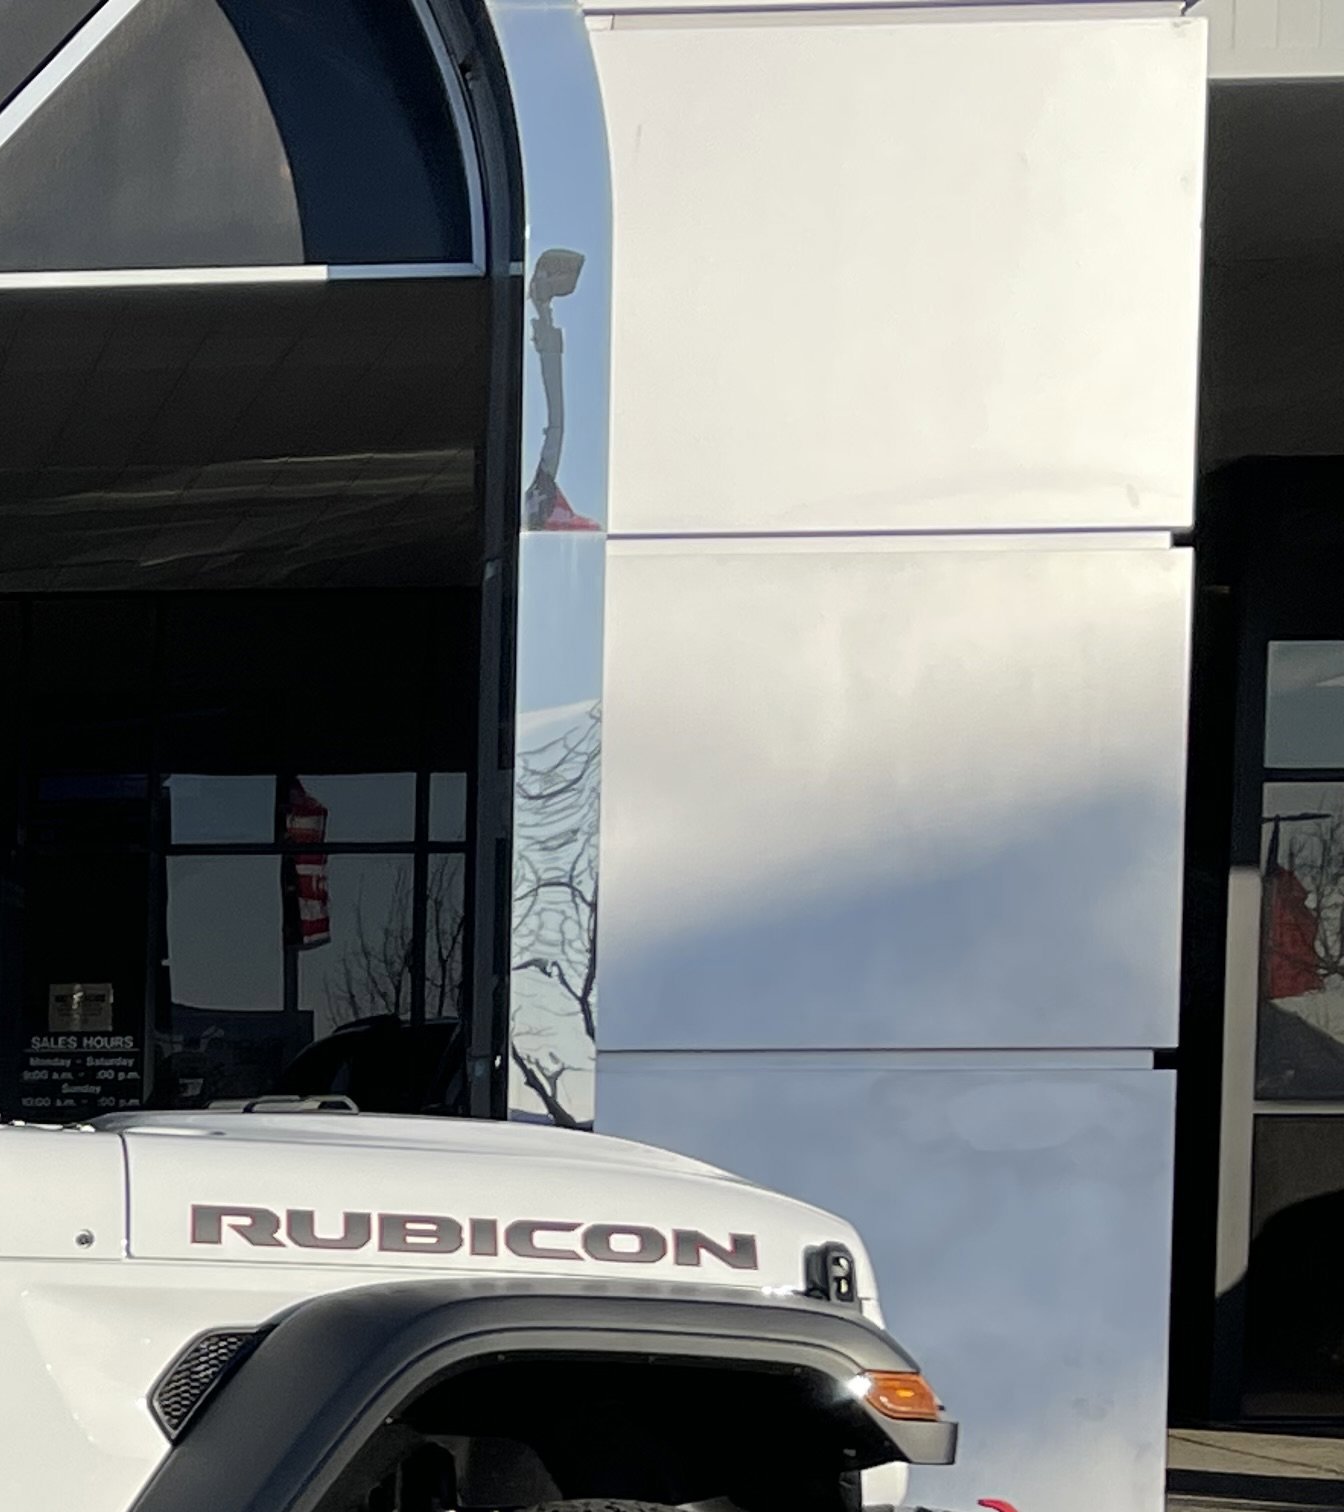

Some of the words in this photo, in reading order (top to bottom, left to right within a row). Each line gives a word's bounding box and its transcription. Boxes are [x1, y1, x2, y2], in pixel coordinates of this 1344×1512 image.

[31, 1036, 77, 1049] SALES
[83, 1036, 133, 1048] HOURS
[190, 1203, 759, 1270] RUBICON
